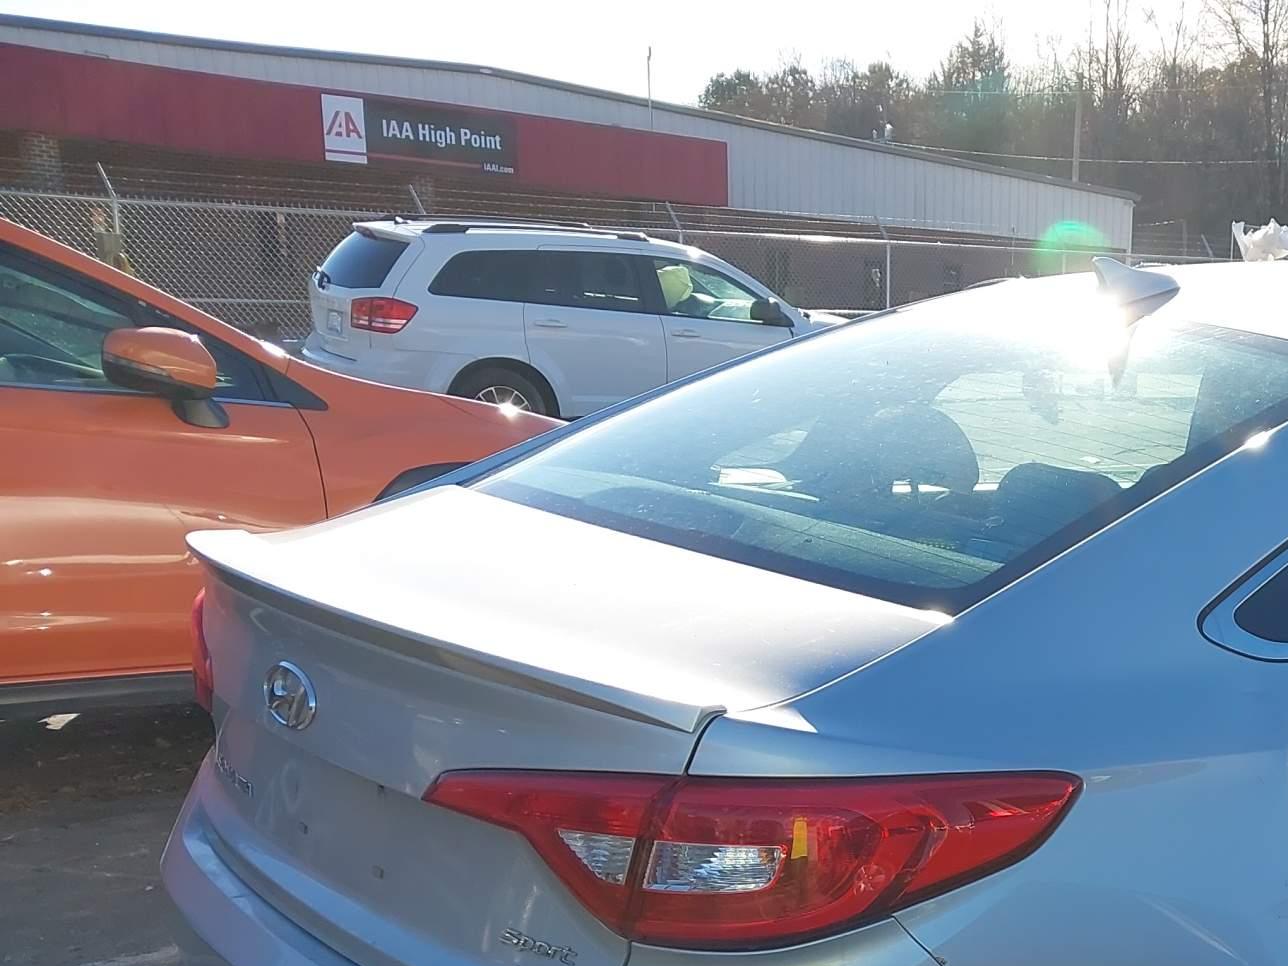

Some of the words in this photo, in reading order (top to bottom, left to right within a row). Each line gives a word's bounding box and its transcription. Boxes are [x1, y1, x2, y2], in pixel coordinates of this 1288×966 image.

[382, 119, 414, 140] IAA
[418, 123, 456, 148] High
[460, 128, 502, 150] Point
[499, 927, 578, 966] Sport
